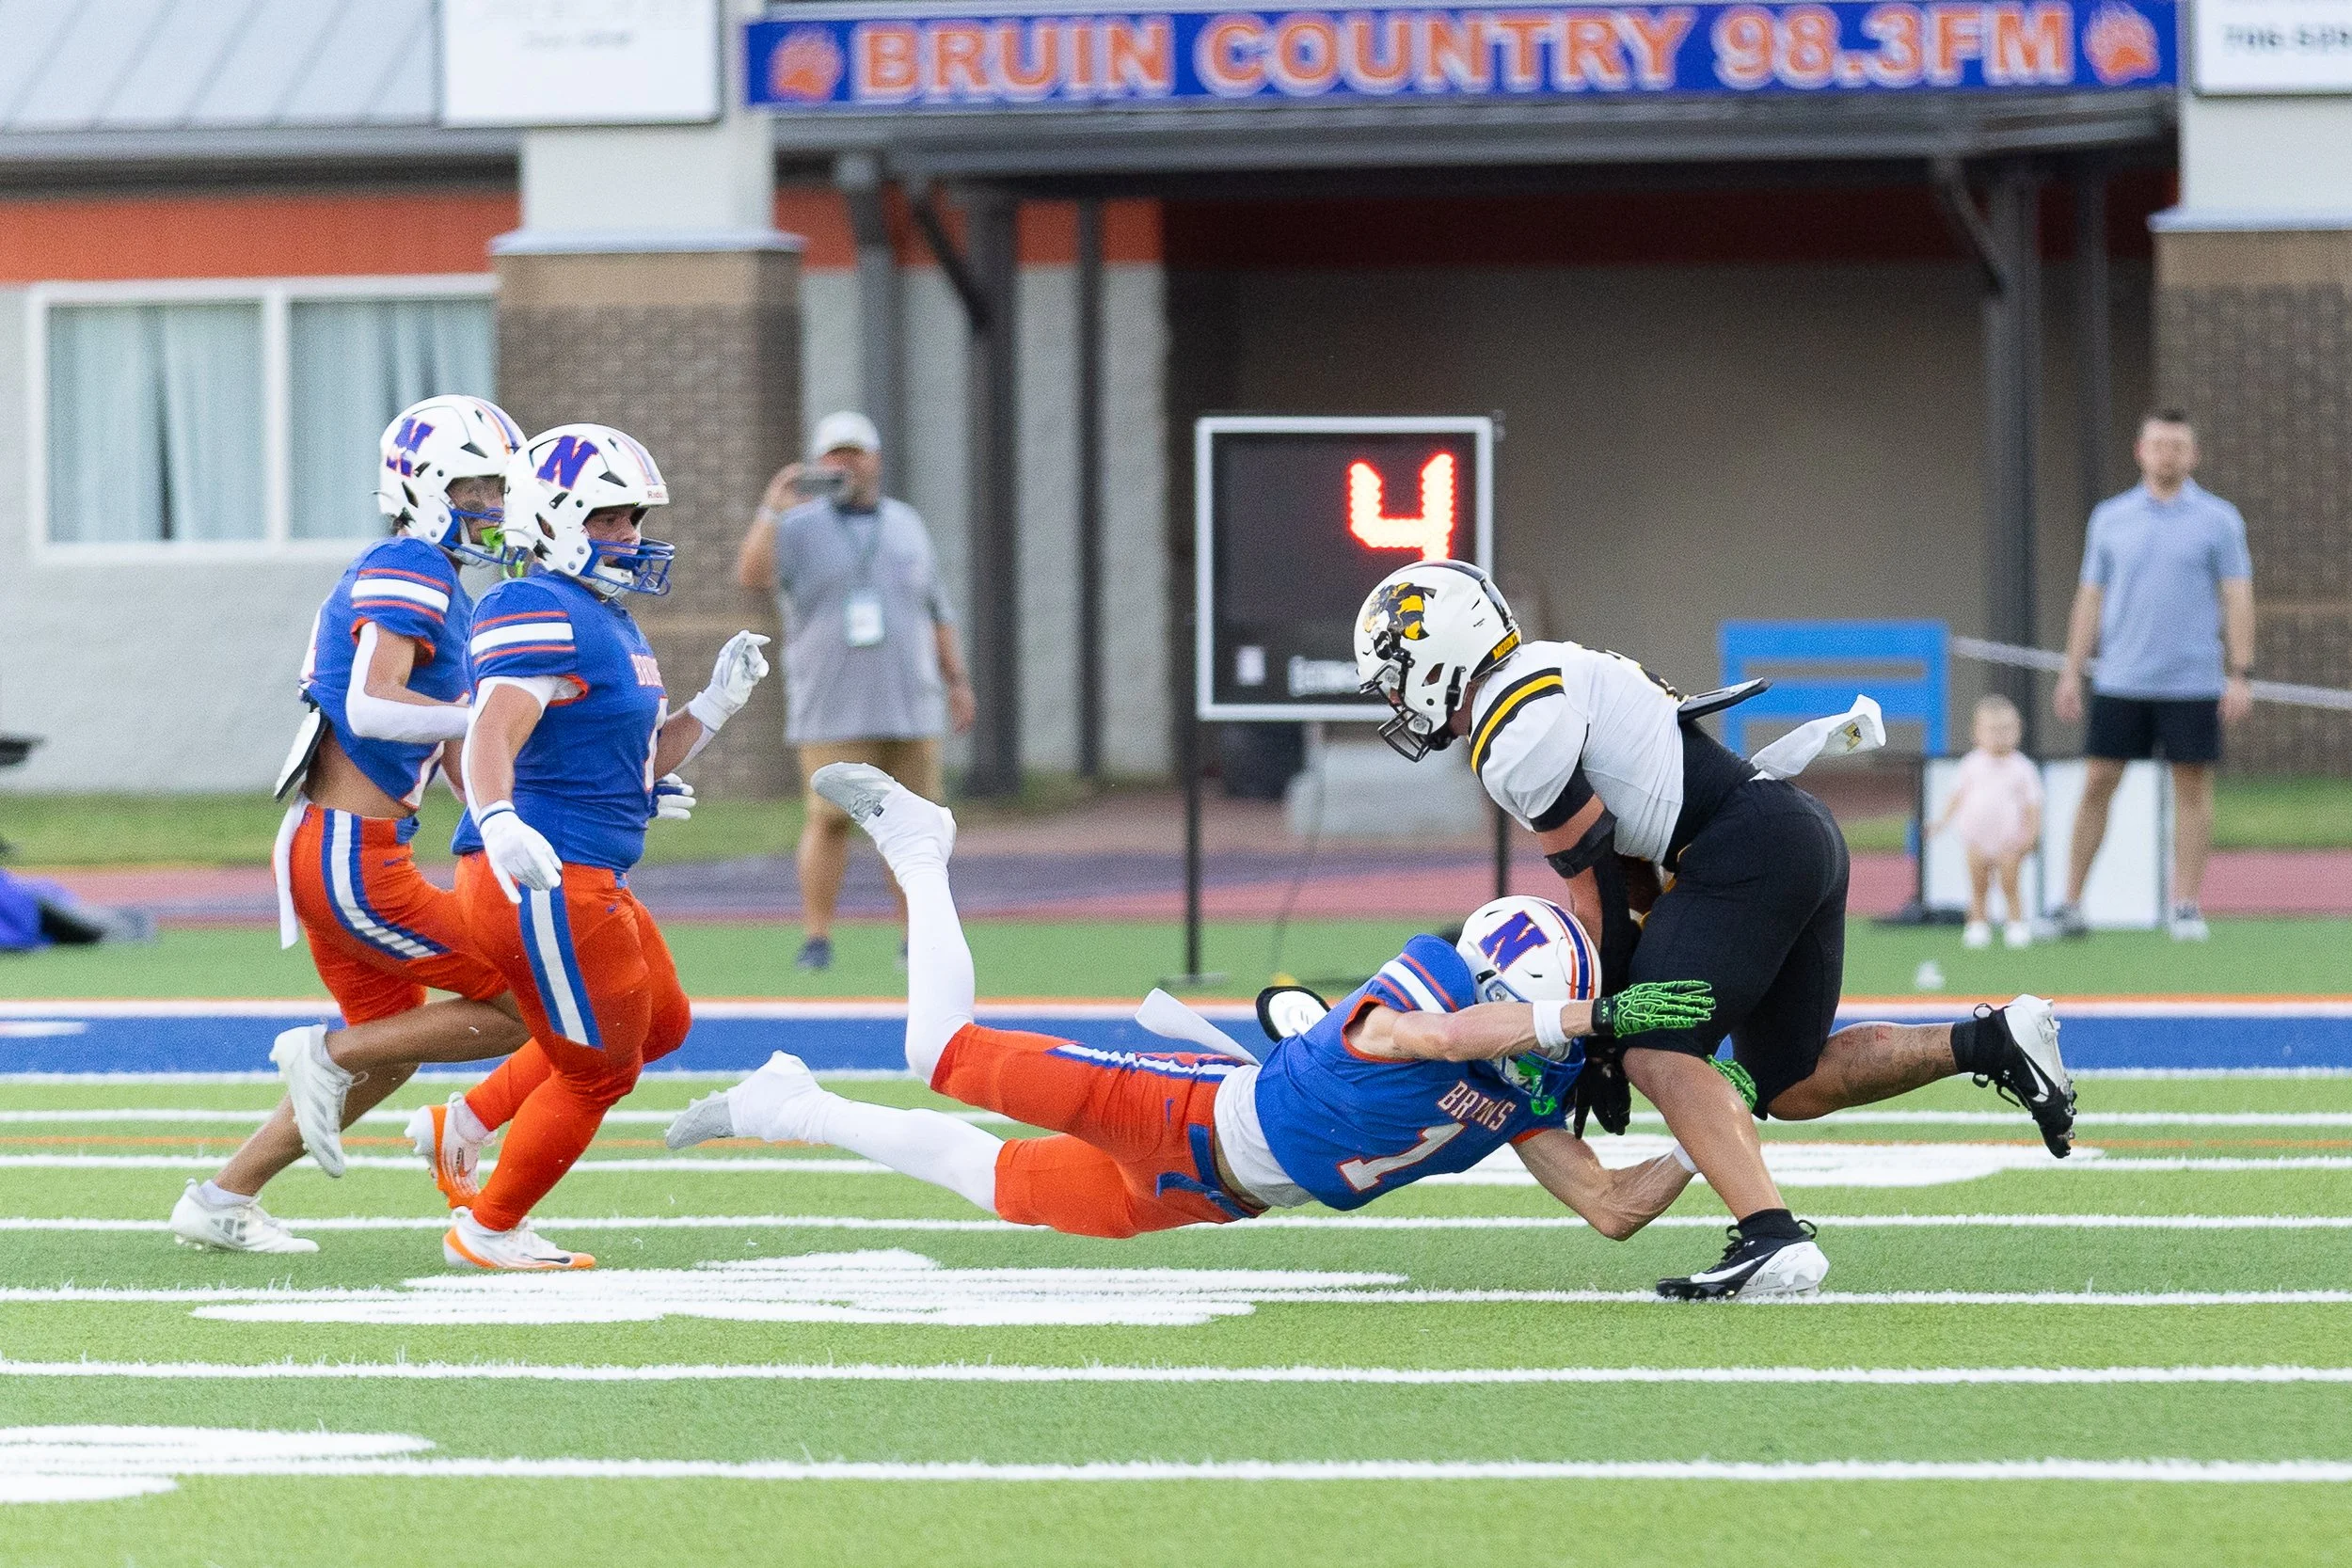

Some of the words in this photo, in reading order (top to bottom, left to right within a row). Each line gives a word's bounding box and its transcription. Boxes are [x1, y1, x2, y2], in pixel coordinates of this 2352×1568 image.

[855, 21, 1171, 100] BRUIN
[1195, 11, 1695, 95] COUNTRY
[1712, 6, 2072, 88] 98.3FM
[386, 417, 436, 478] N
[535, 435, 598, 491] N
[1349, 449, 1454, 562] 4
[1479, 911, 1550, 974] N
[1337, 1121, 1467, 1192] 1
